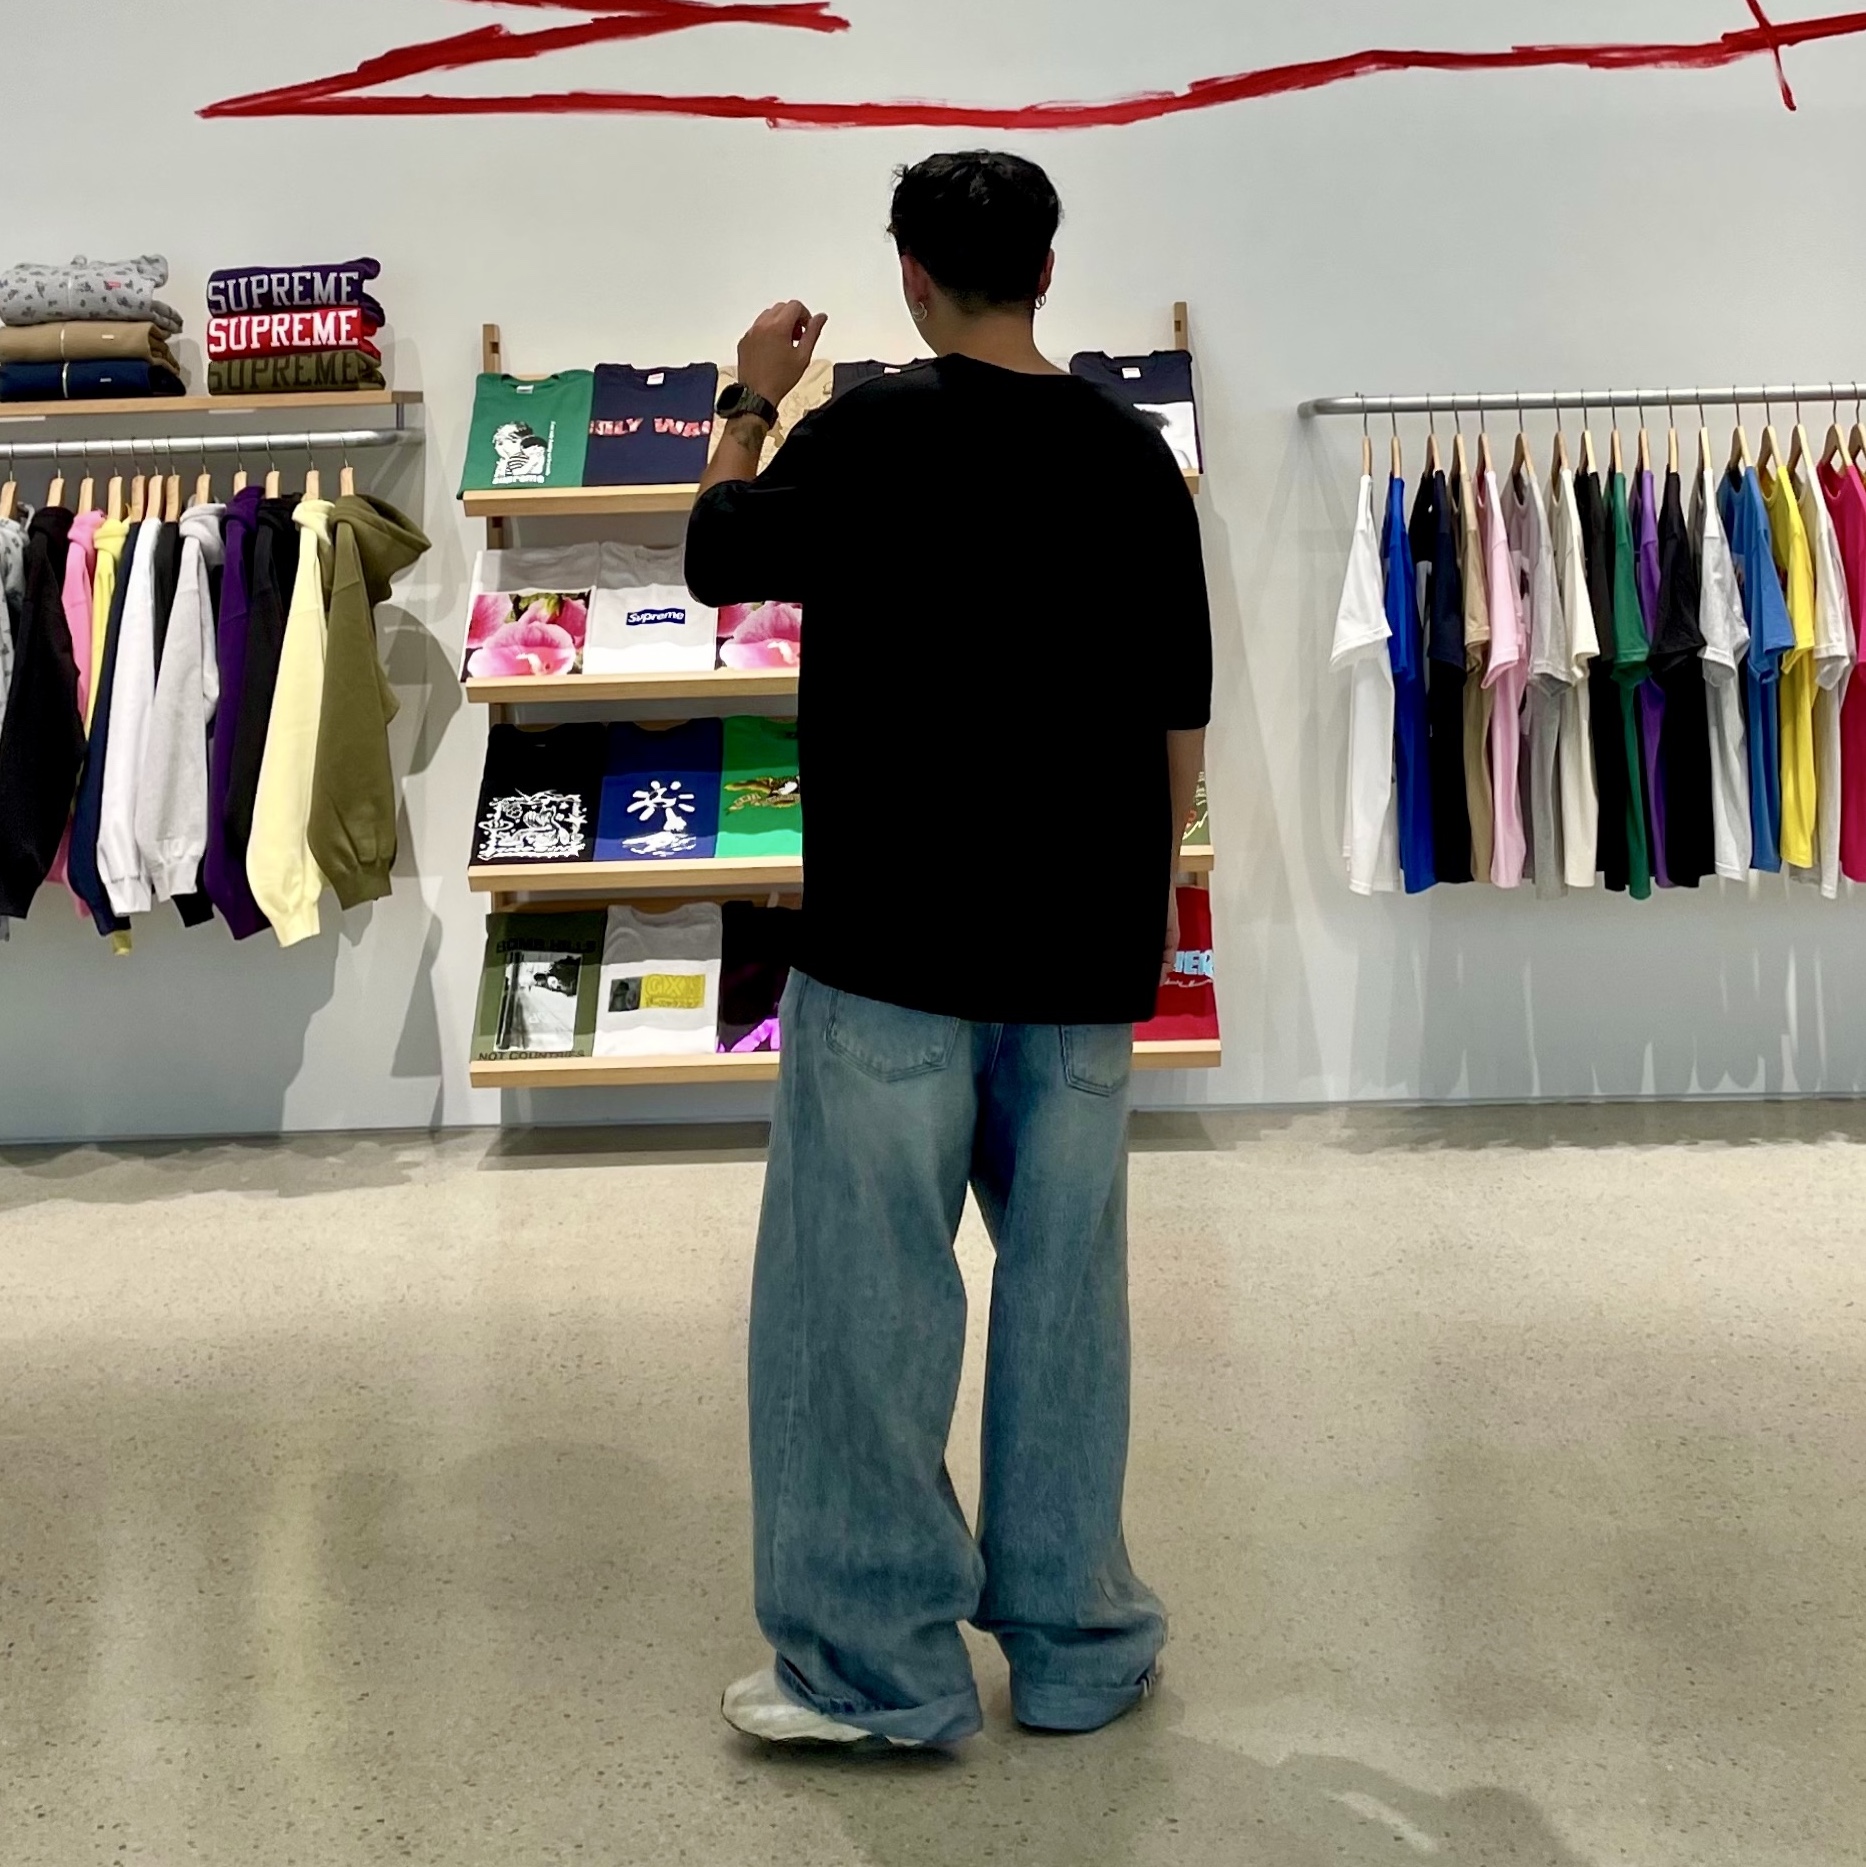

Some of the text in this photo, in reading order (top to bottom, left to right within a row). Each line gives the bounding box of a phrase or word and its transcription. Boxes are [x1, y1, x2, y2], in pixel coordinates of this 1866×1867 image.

[207, 271, 359, 315] SUPREME
[208, 309, 359, 353] SUPREME
[210, 352, 359, 391] SUPREME
[628, 611, 685, 624] Supreme
[478, 1051, 507, 1061] NOT
